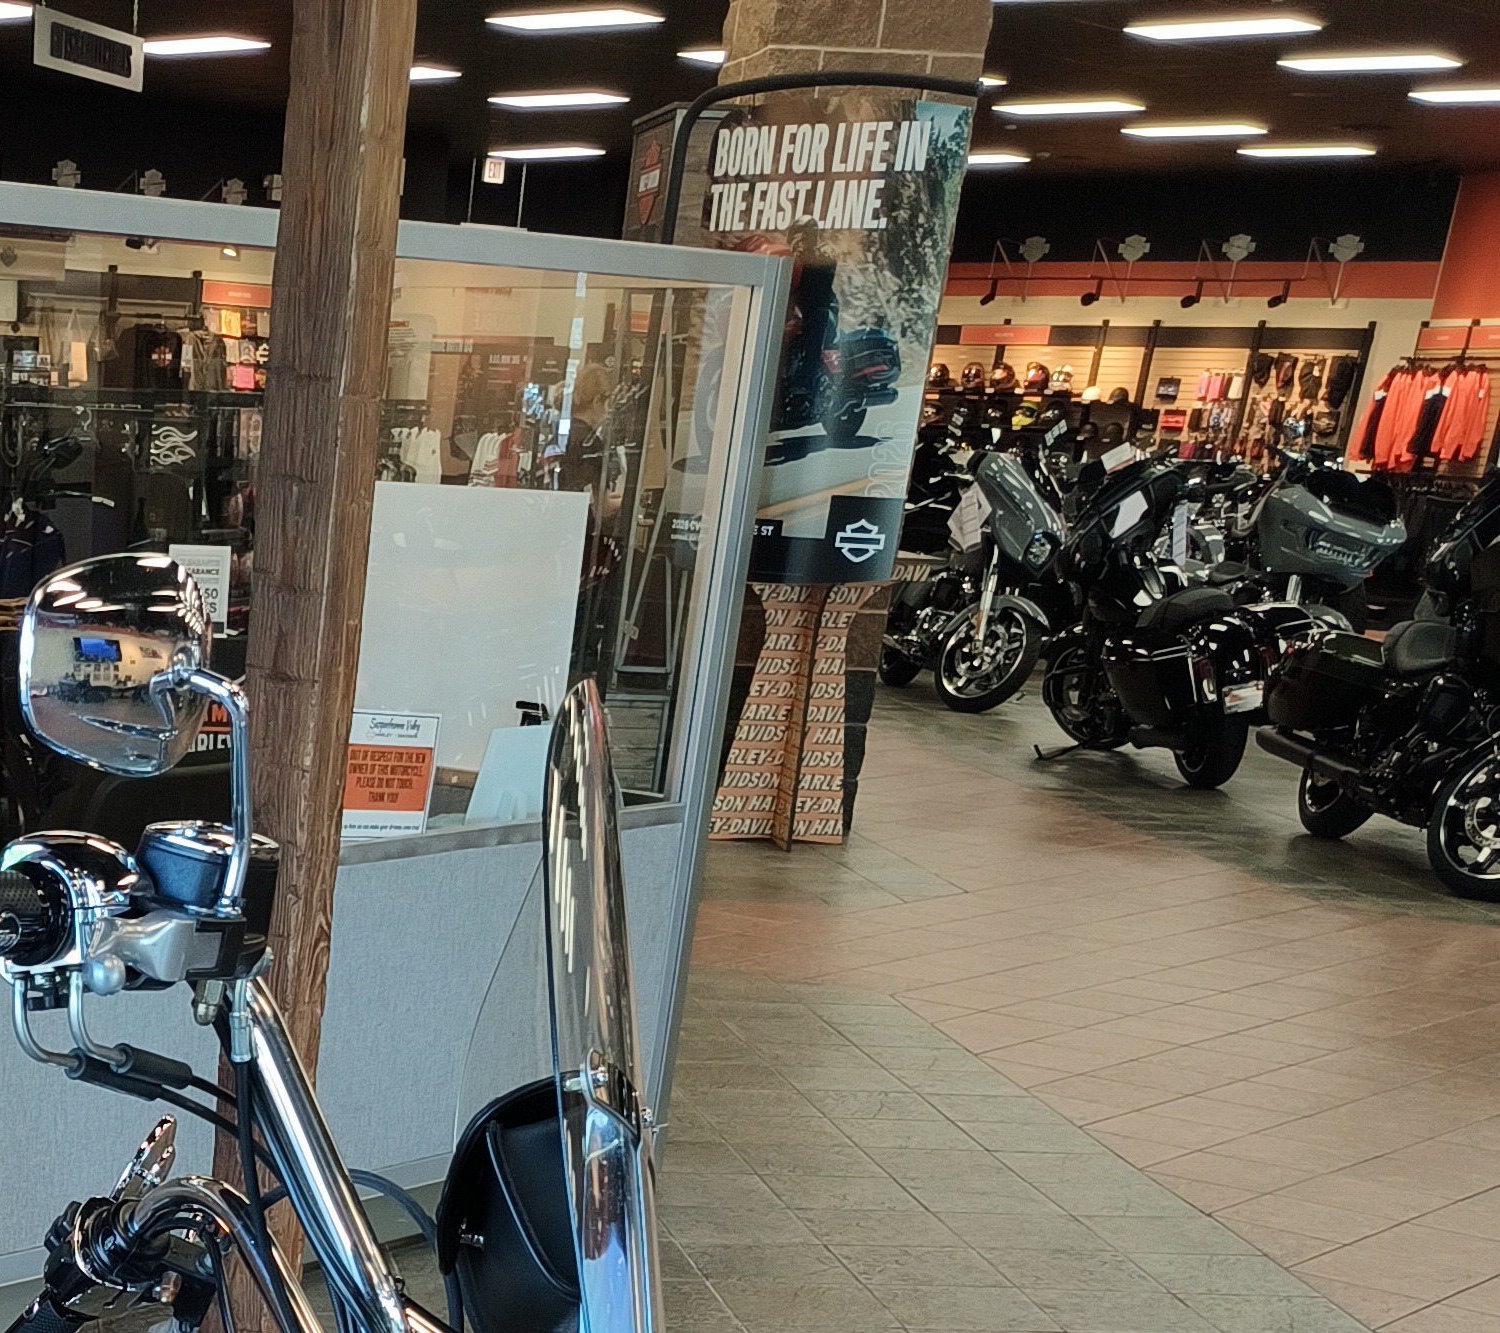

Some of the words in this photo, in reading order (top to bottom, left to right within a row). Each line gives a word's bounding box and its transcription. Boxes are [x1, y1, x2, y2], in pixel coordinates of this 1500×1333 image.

[713, 125, 778, 178] BORN
[777, 123, 830, 175] FOR
[831, 121, 894, 174] LIFE
[893, 120, 932, 172] IN
[708, 182, 750, 232] THE
[749, 180, 812, 231] FAST
[812, 179, 888, 230] LANE.
[760, 525, 775, 537] ST
